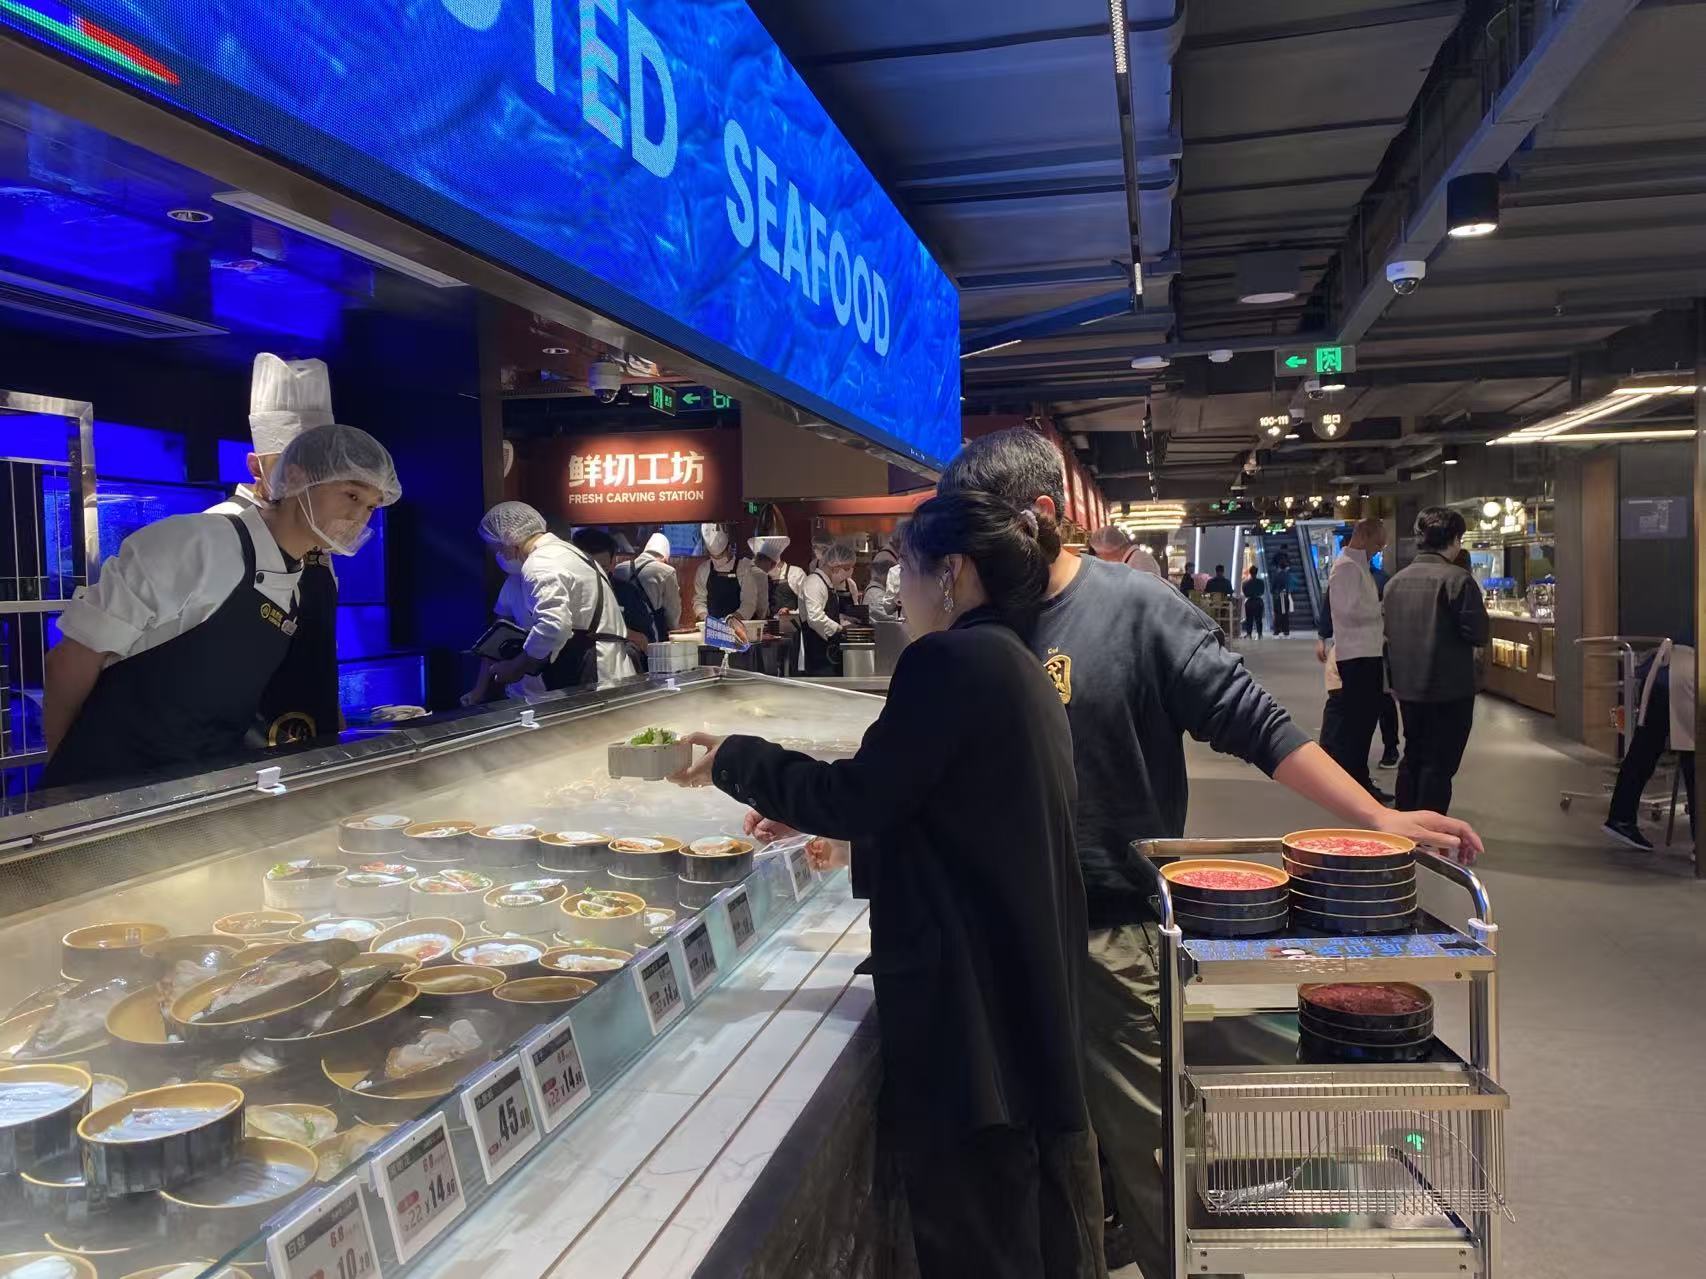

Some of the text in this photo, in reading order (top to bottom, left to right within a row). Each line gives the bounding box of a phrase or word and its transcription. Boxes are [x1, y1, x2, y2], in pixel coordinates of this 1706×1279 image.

[723, 119, 890, 357] SEAFOOD
[1260, 415, 1289, 426] 100-111
[1323, 414, 1341, 424] 出口
[568, 450, 705, 488] 鲜切工坊
[568, 489, 704, 505] FRESH CARVING STATION
